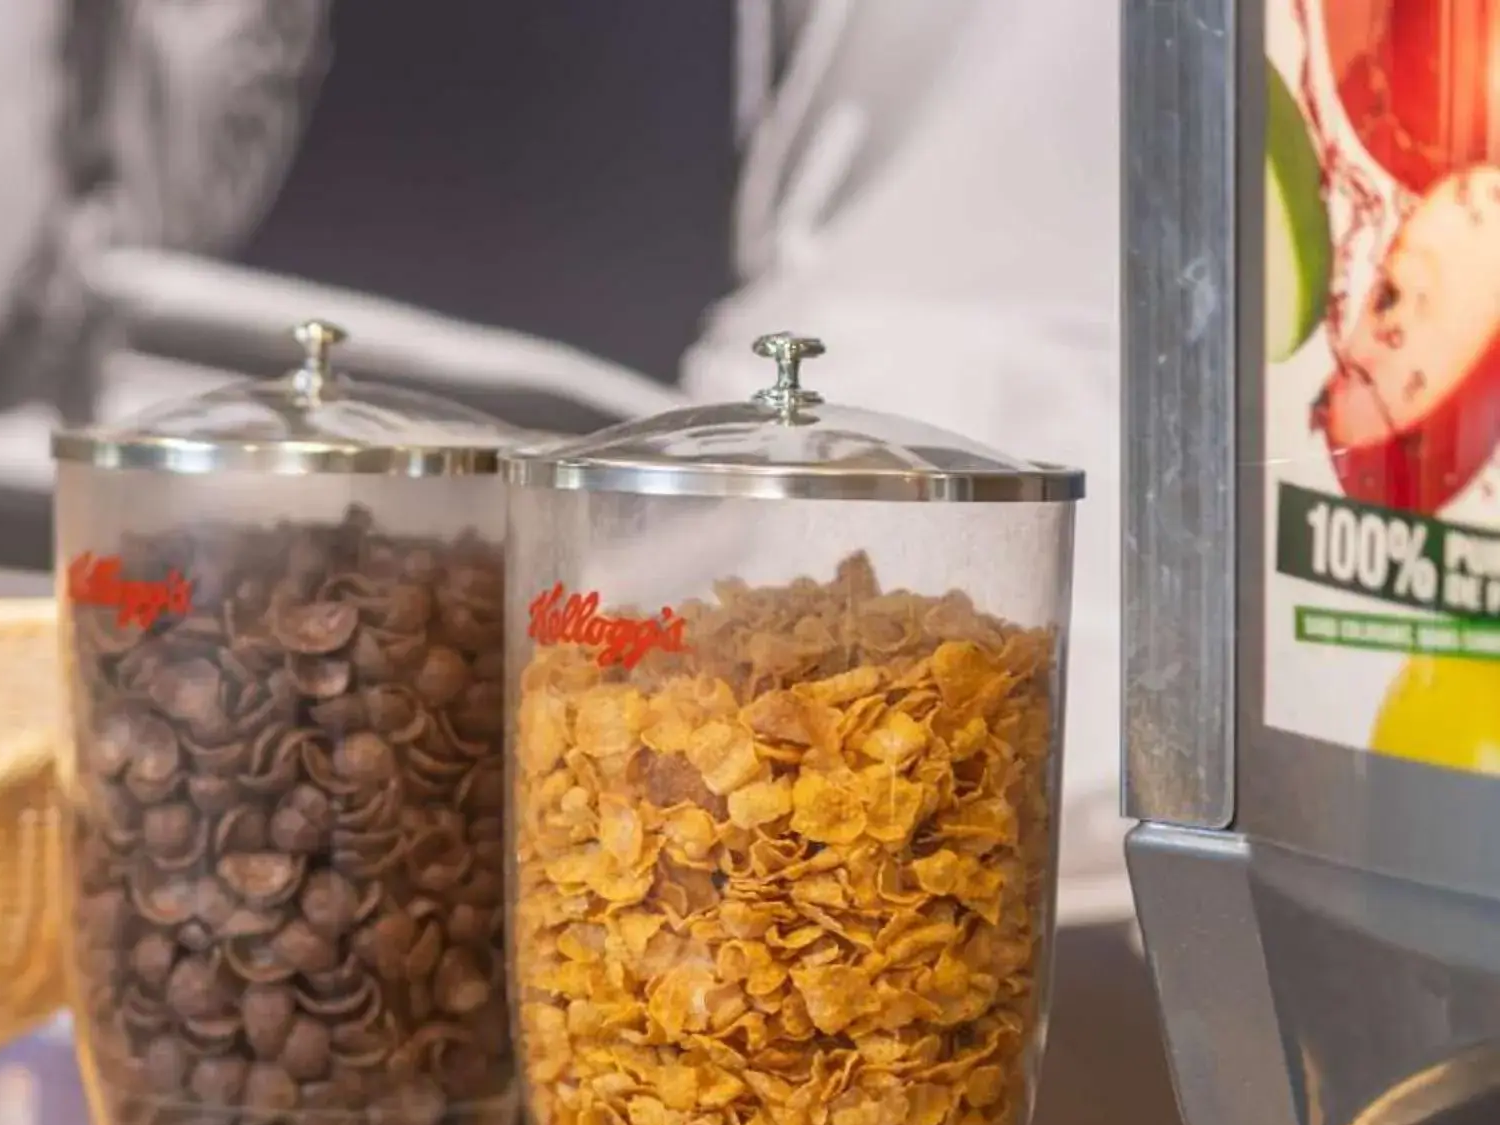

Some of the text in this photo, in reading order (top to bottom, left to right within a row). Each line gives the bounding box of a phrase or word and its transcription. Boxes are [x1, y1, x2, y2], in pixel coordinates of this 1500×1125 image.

[69, 551, 193, 630] Kellogg's
[1307, 502, 1439, 603] 100%
[528, 580, 686, 671] Kellogg's
